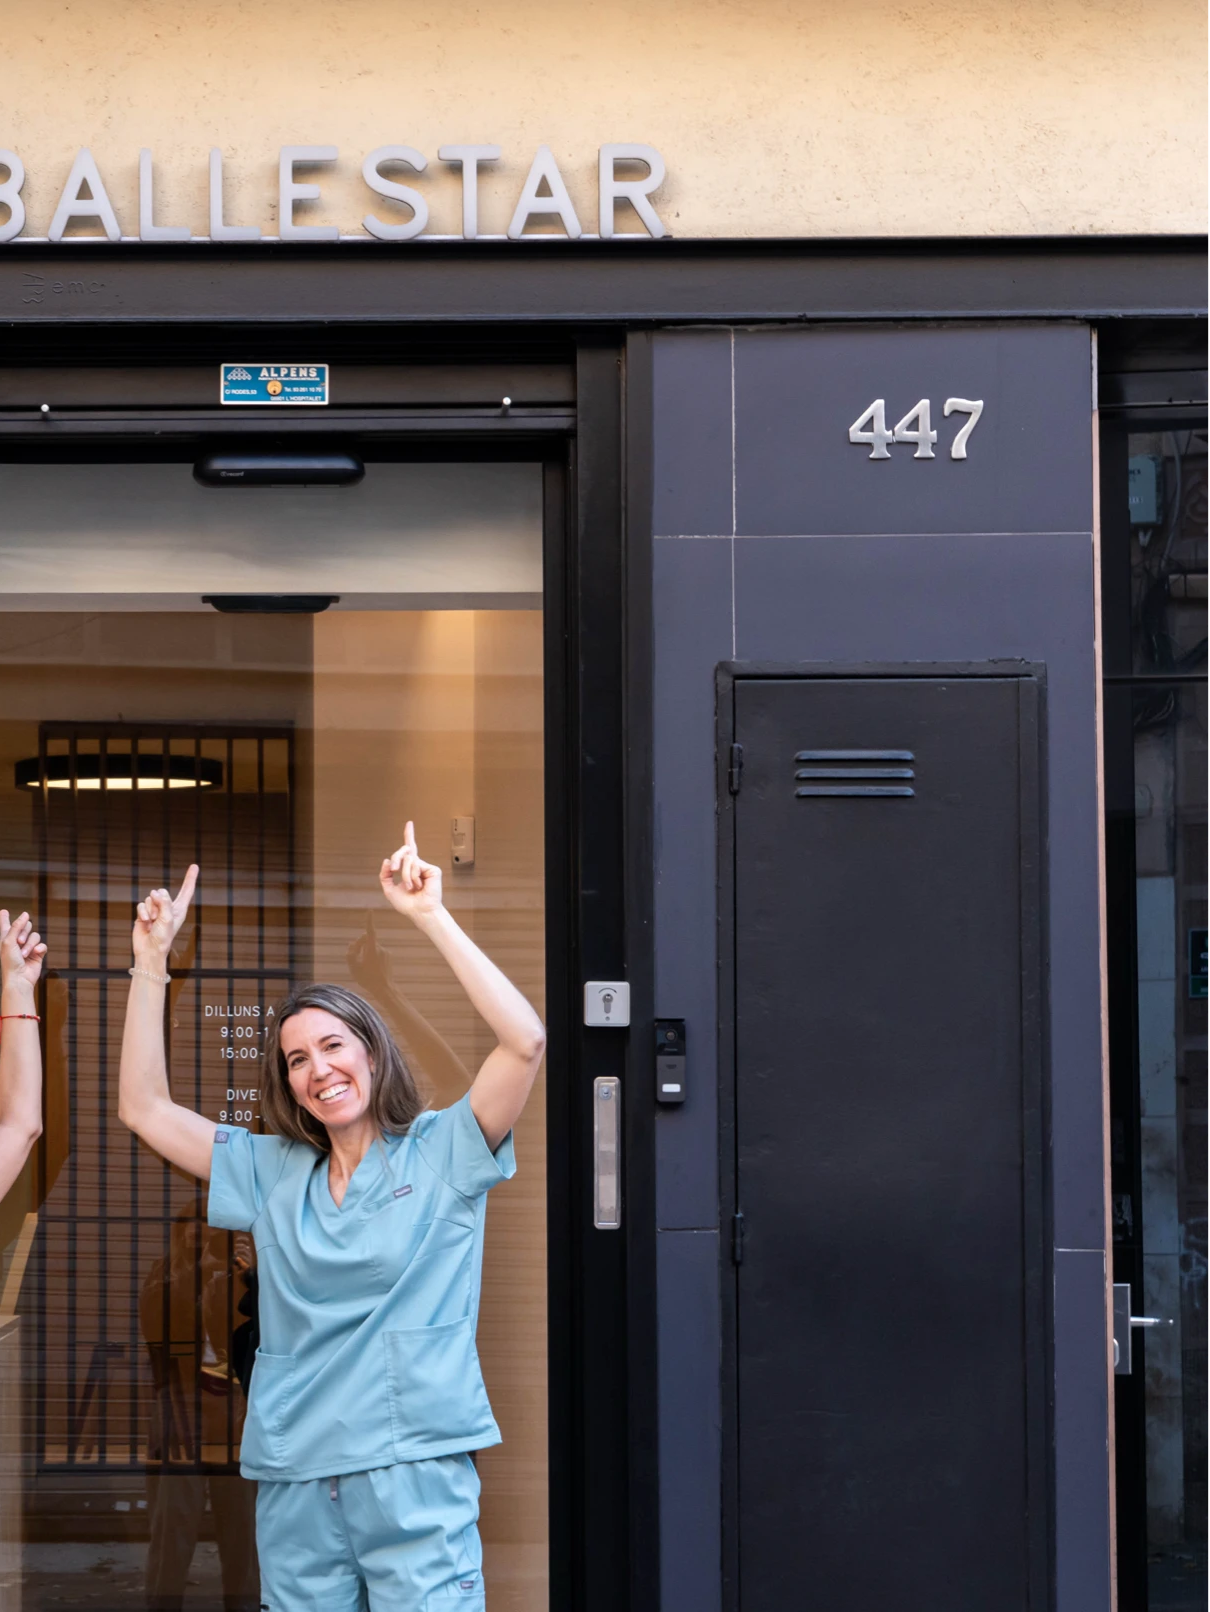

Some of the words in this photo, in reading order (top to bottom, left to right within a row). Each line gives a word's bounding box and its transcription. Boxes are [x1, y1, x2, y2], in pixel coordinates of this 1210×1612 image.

[260, 367, 317, 377] ALPENS
[848, 398, 984, 459] 447
[205, 1005, 260, 1016] DILLUNS
[266, 1005, 275, 1016] A
[226, 1089, 261, 1101] DIVE
